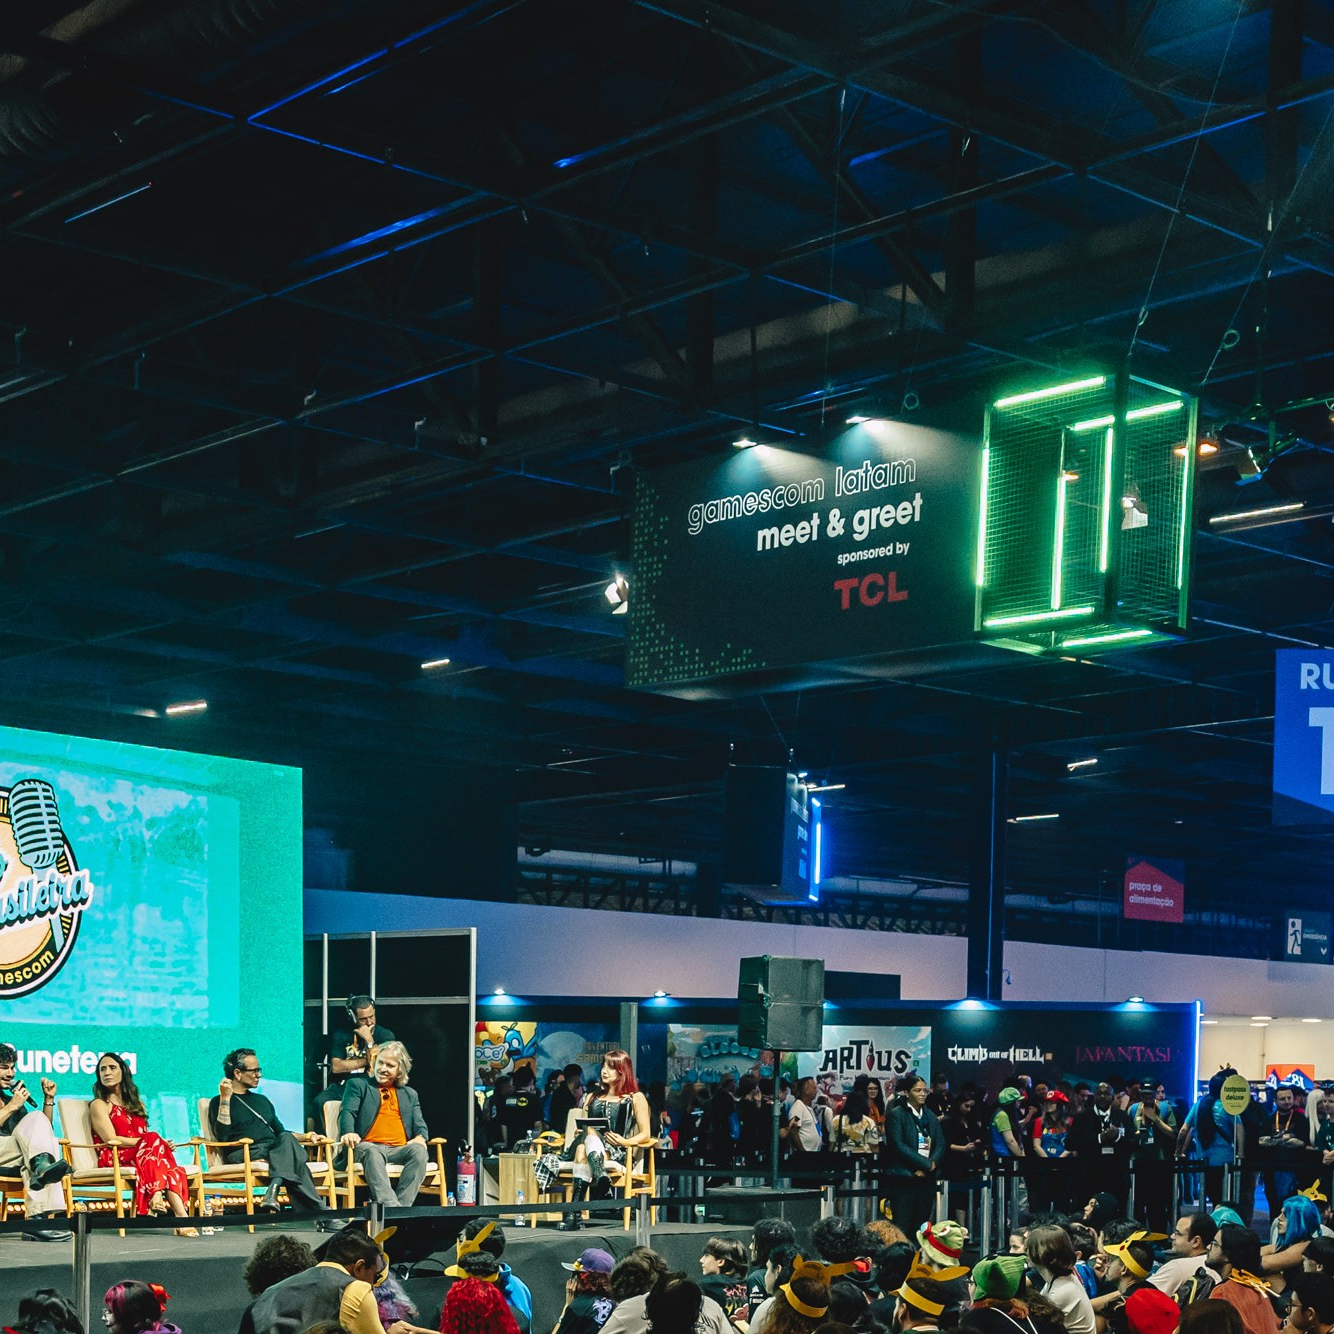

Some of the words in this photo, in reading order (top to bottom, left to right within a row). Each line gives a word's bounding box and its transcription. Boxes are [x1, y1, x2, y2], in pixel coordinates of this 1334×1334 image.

[687, 475, 825, 535] gamescom
[835, 456, 917, 498] latam
[757, 514, 821, 552] meet
[827, 509, 848, 537] &
[852, 492, 923, 540] greet
[836, 544, 894, 565] sponsored
[895, 540, 910, 557] by
[834, 570, 908, 610] TCL
[947, 1044, 988, 1065] CLIMB
[1009, 1044, 1045, 1065] HELL
